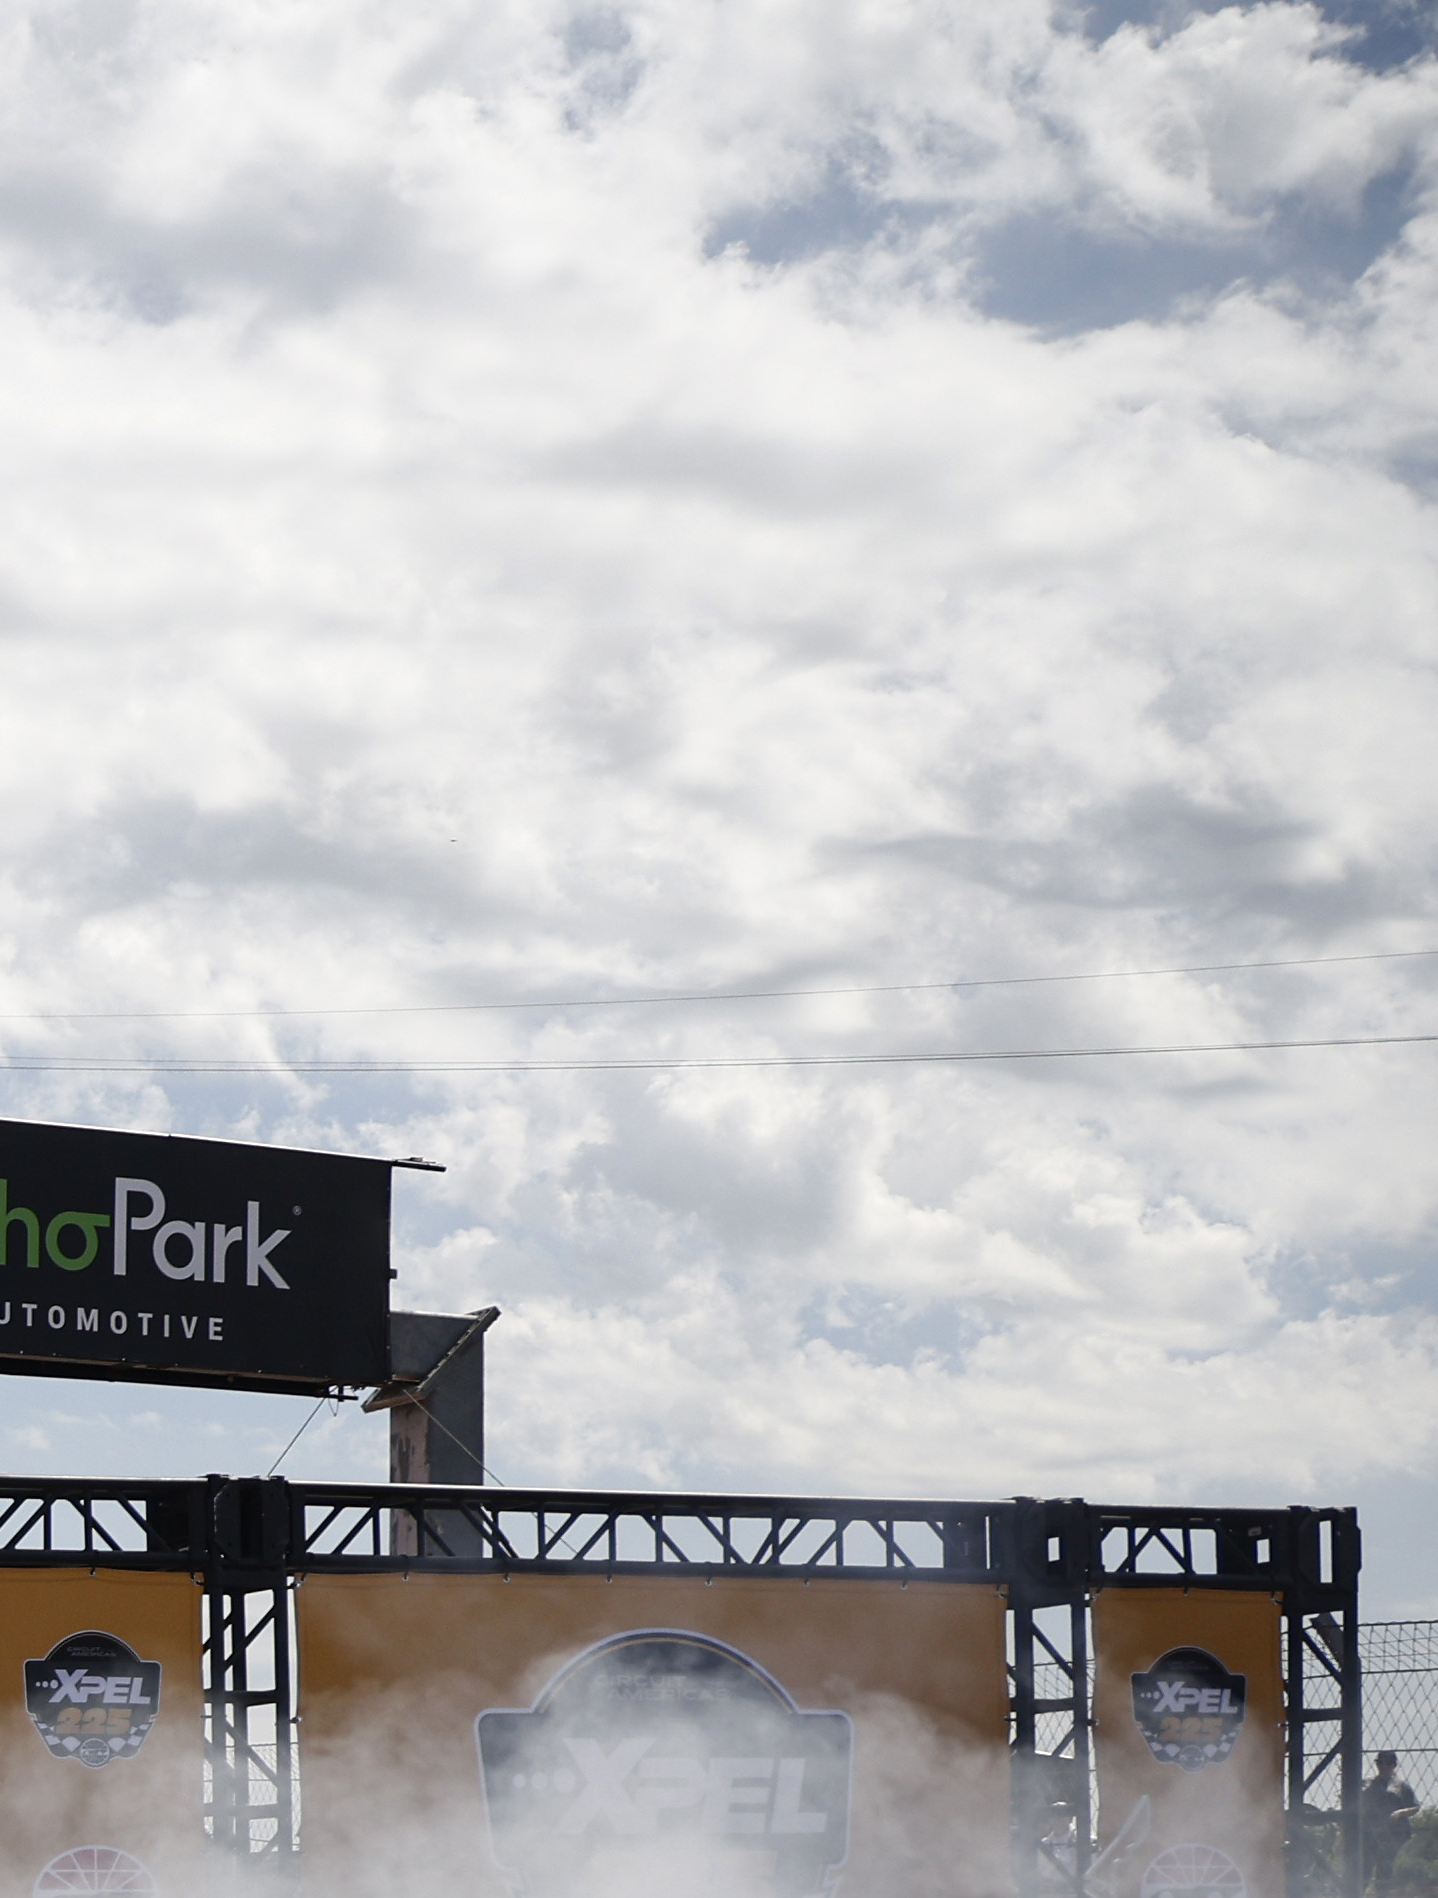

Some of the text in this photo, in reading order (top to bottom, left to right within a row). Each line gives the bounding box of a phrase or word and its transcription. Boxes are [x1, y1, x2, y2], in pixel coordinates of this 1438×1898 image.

[48, 1668, 151, 1704] XPEL
[1152, 1681, 1238, 1714] XPEL
[55, 1707, 133, 1735] 225
[1158, 1717, 1224, 1743] 225
[559, 1737, 828, 1834] XPEL
